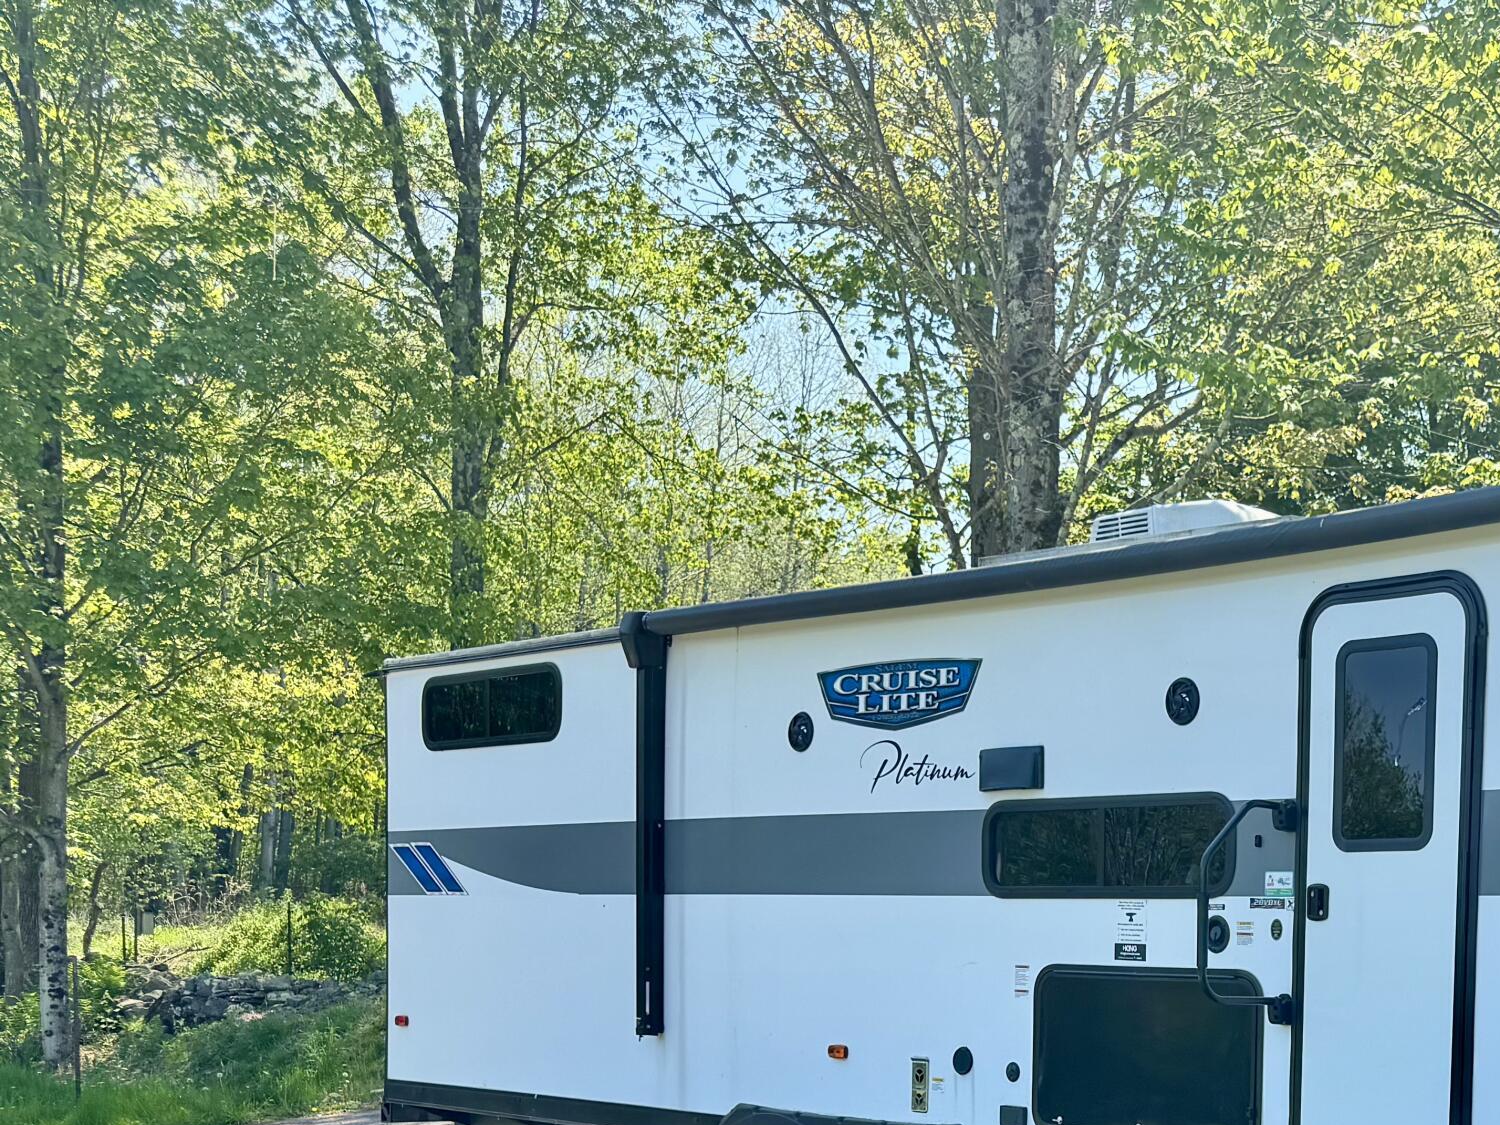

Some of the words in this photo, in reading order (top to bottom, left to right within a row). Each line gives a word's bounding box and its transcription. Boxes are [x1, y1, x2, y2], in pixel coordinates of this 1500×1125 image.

[833, 666, 960, 695] CRUISE
[856, 690, 939, 714] LITE
[860, 739, 975, 794] Platinum
